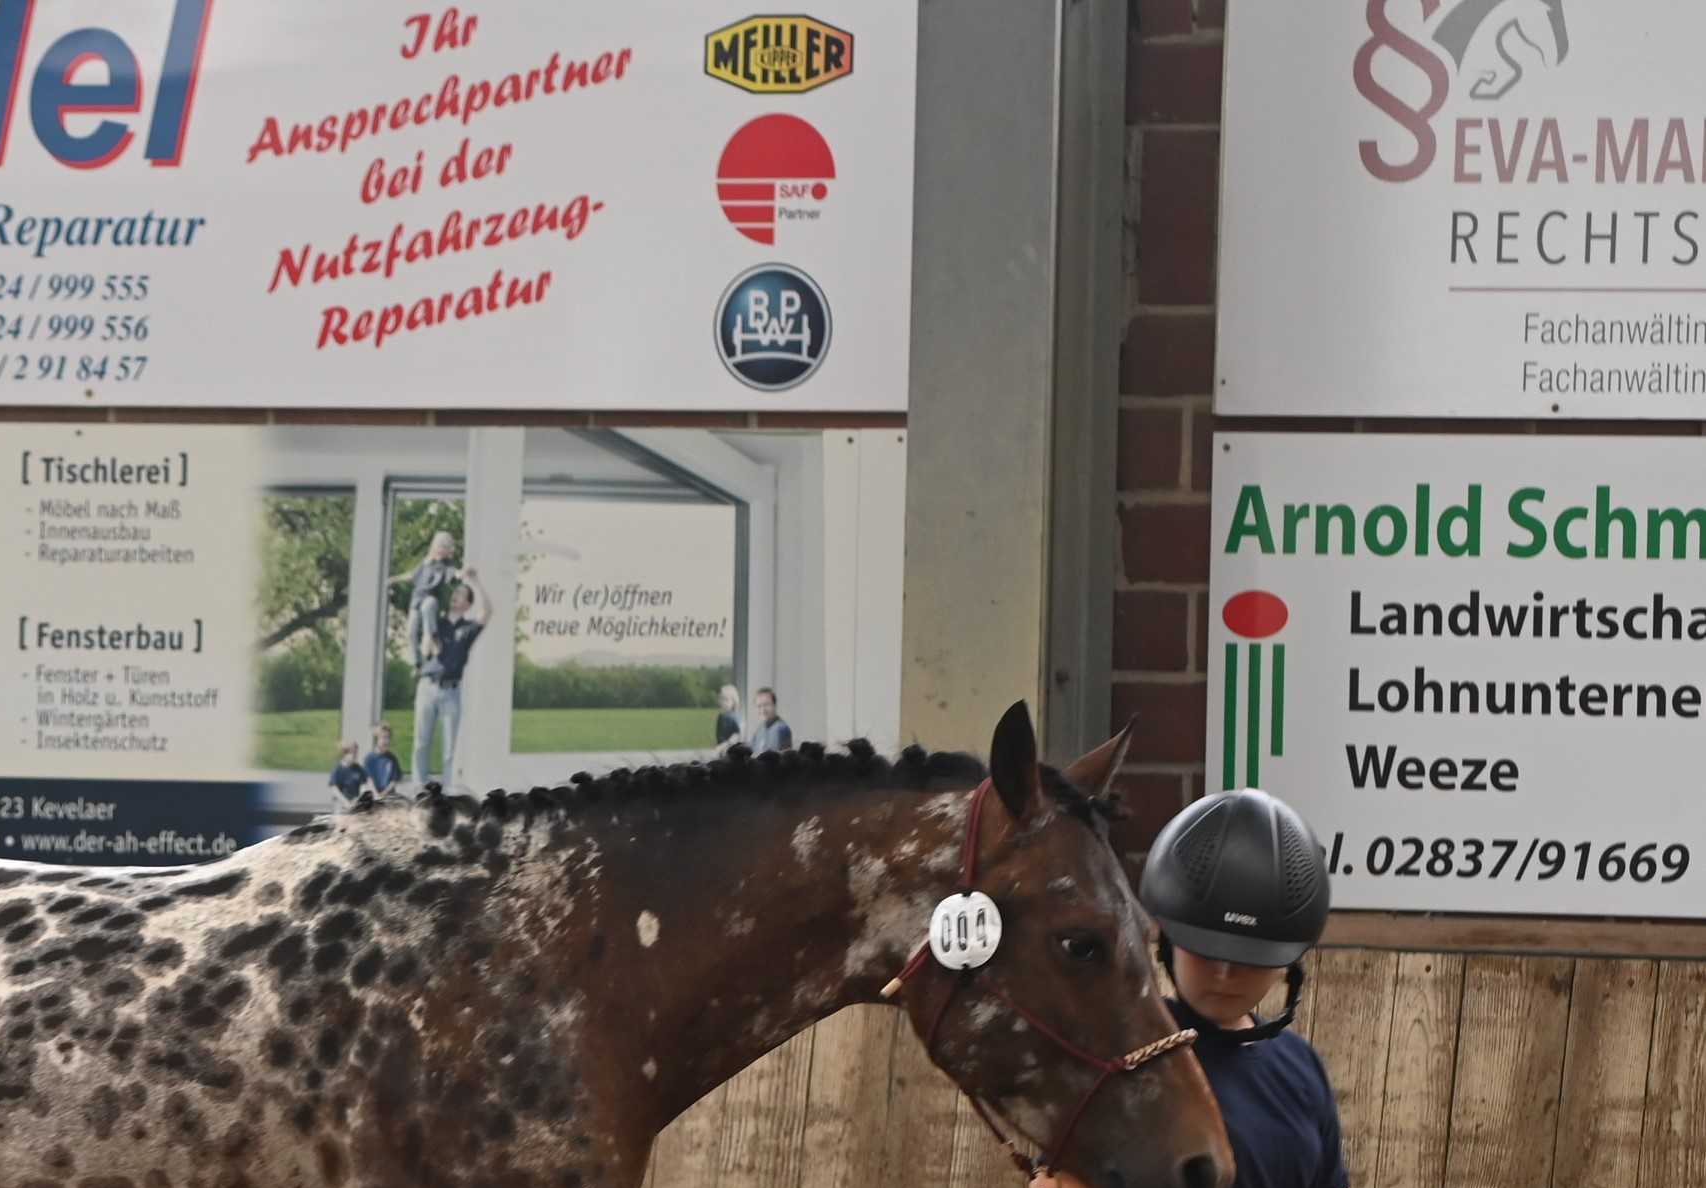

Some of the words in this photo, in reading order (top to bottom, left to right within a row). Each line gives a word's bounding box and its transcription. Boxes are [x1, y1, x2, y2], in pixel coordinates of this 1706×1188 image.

[400, 6, 479, 60] Ihr
[714, 24, 843, 84] MEILLER
[245, 47, 633, 164] Ansprechpartner
[1453, 117, 1706, 184] EVA-MA
[361, 150, 425, 205] bei
[439, 137, 513, 188] der
[779, 207, 821, 220] Partner
[267, 194, 606, 294] Nutzfahrzeug-
[1451, 210, 1700, 266] RECHTS
[49, 275, 94, 298] 999
[102, 275, 149, 300] 555
[316, 269, 552, 350] Reparatur
[48, 316, 94, 339] 999
[102, 316, 148, 341] 556
[14, 355, 28, 380] 2
[39, 356, 66, 380] 91
[76, 356, 108, 380] 84
[115, 356, 148, 381] 57
[1521, 361, 1706, 393] Fachanwältin
[42, 457, 170, 484] Tischlerei
[39, 501, 91, 518] Möbel
[97, 501, 138, 518] nach
[146, 501, 181, 519] Maß
[1224, 484, 1482, 557] Arnold
[39, 522, 151, 540] Innenausbau
[39, 544, 194, 564] Reparaturarbeiten
[535, 585, 565, 604] Wir
[572, 583, 673, 610] (er)öffnen
[37, 623, 183, 650] Fensterbau
[533, 617, 580, 636] neue
[586, 615, 727, 642] Möglichkeiten!
[36, 665, 97, 683] Fenster
[123, 665, 170, 684] Türen
[37, 687, 54, 704] in
[61, 687, 98, 705] Holz
[129, 688, 217, 707] Kunststoff
[1348, 667, 1703, 719] Lohnunterne
[37, 708, 149, 732] Wintergärten
[37, 731, 168, 751] Insektenschutz
[1346, 745, 1519, 792] Weeze
[31, 797, 116, 820] Kevelaer
[21, 830, 237, 854] www.der-ah-effect.de
[1366, 836, 1690, 883] 02837/91669
